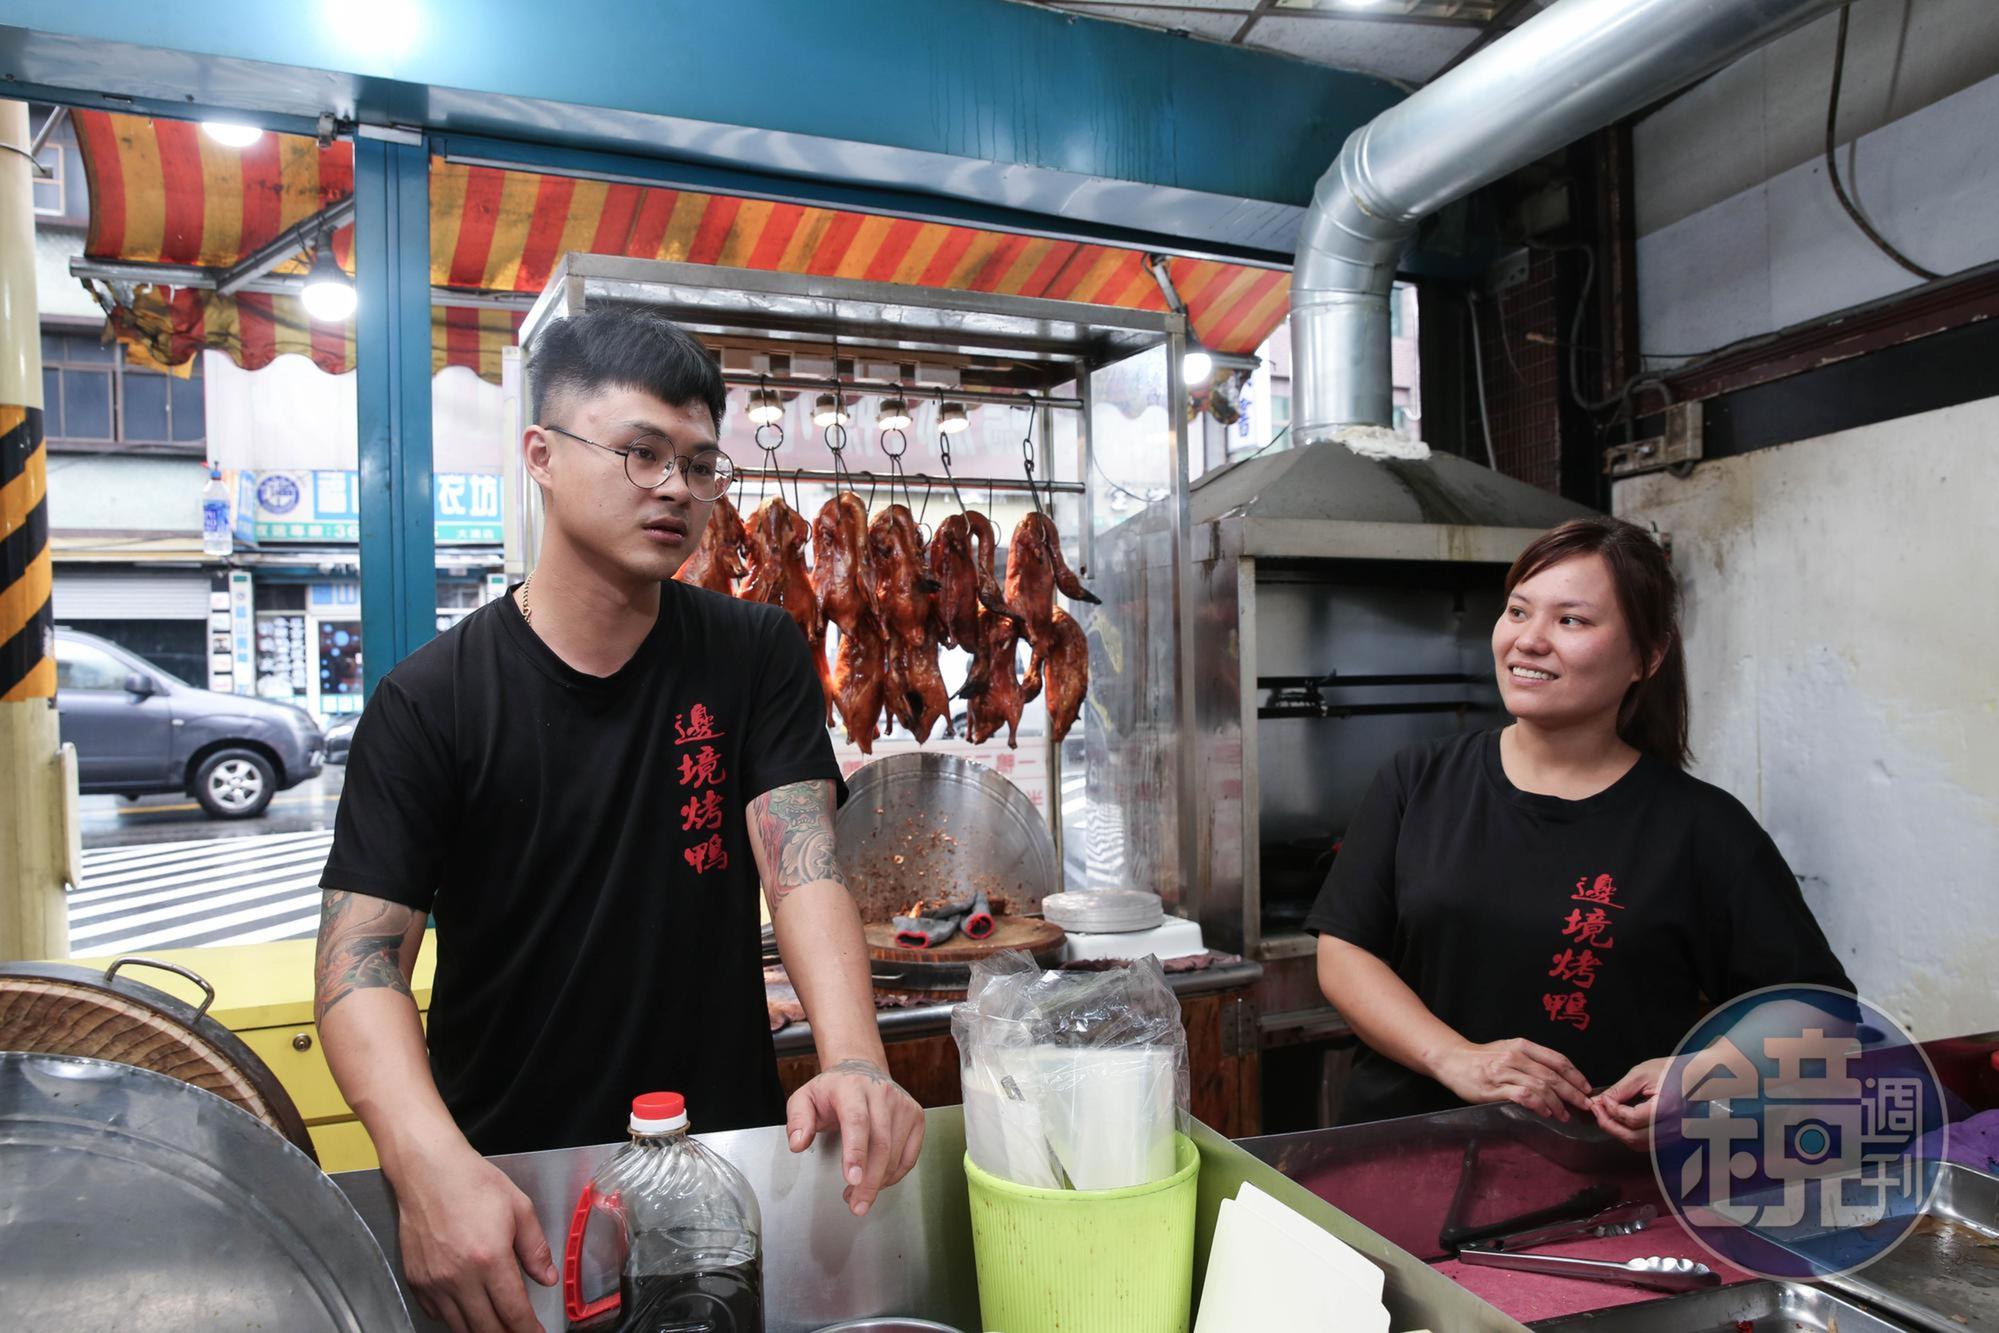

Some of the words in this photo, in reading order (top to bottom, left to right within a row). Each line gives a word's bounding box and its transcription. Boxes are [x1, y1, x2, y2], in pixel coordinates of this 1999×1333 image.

[674, 703, 728, 874] 邊境烤鴨
[1542, 873, 1625, 1031] 邊境烤鴨
